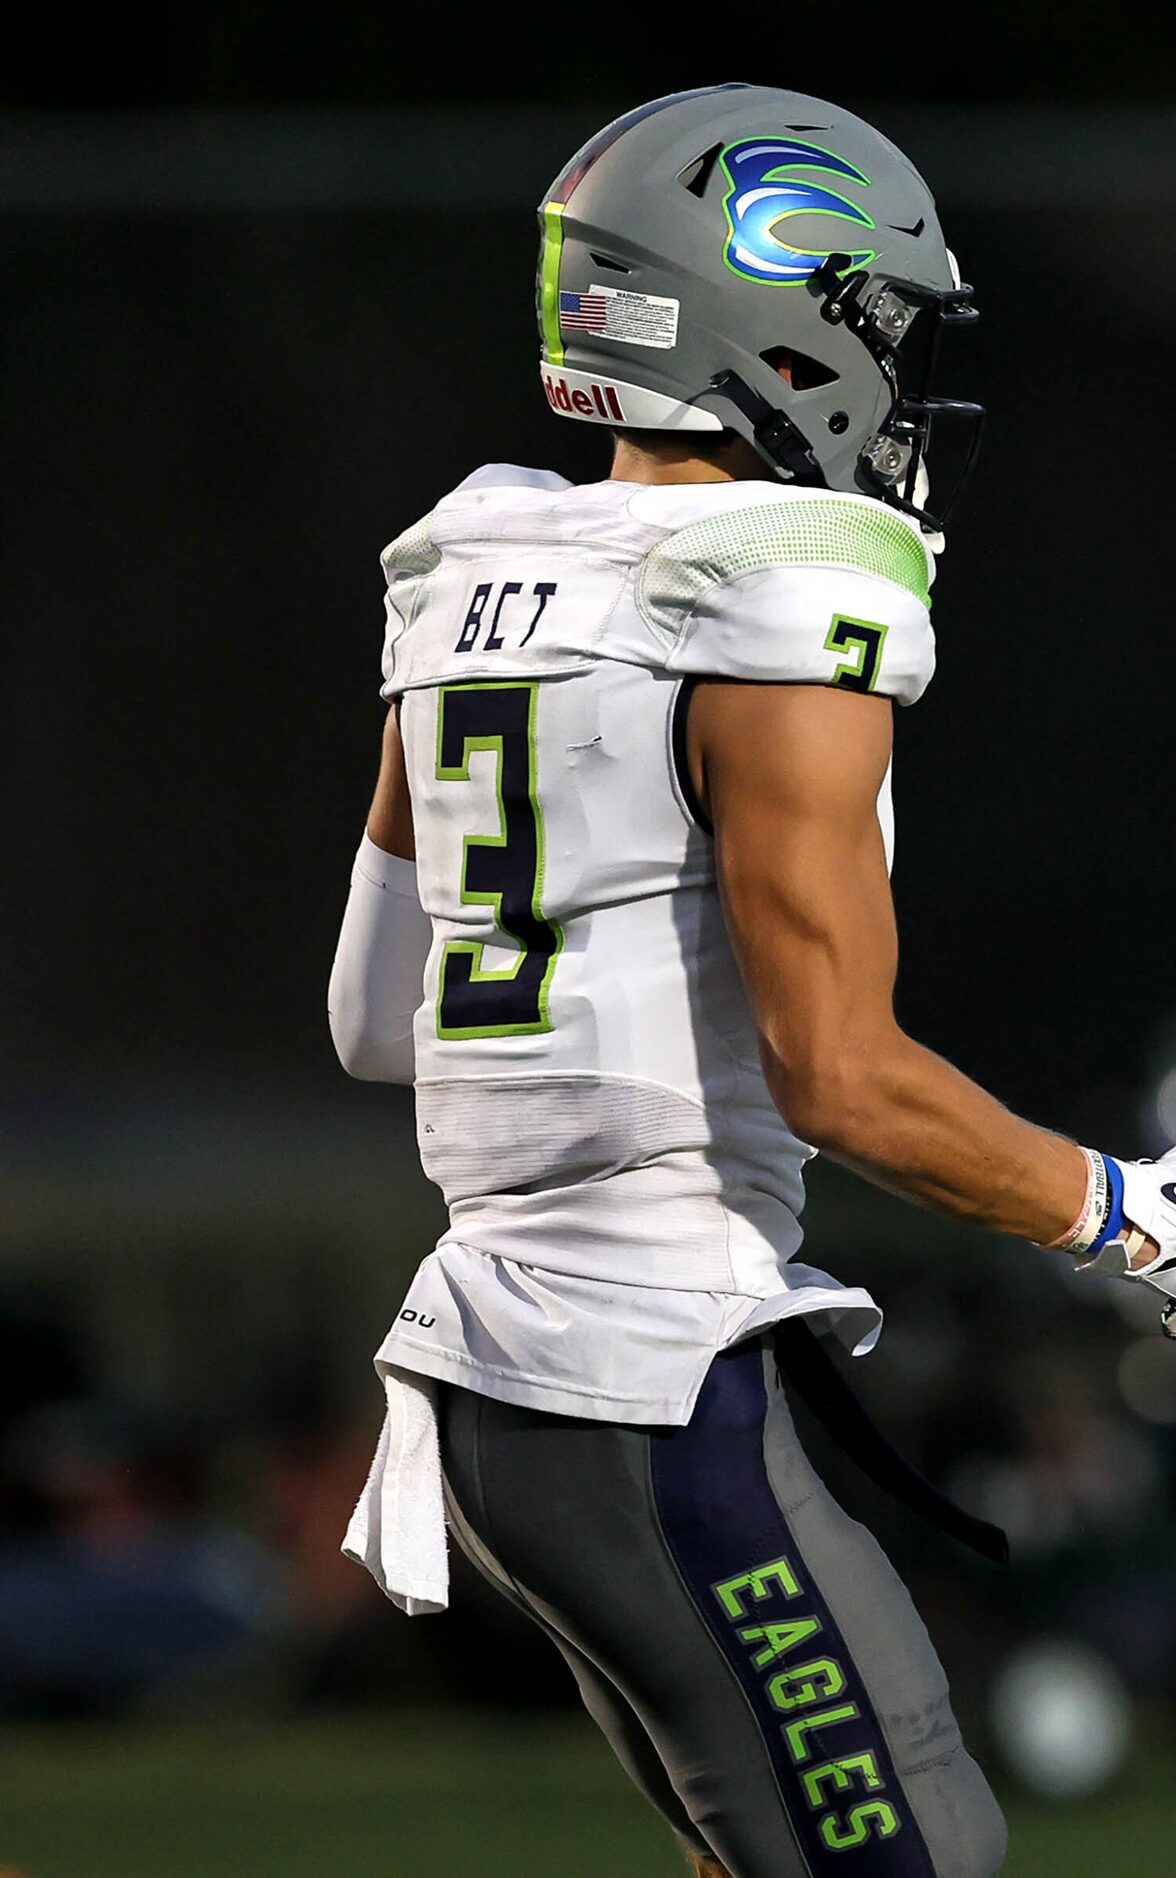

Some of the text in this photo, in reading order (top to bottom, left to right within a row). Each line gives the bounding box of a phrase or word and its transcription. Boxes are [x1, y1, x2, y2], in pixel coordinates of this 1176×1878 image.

[454, 581, 558, 654] BCT
[435, 680, 565, 1041] 3
[399, 1308, 436, 1328] OU
[709, 1555, 901, 1853] EAGLES
